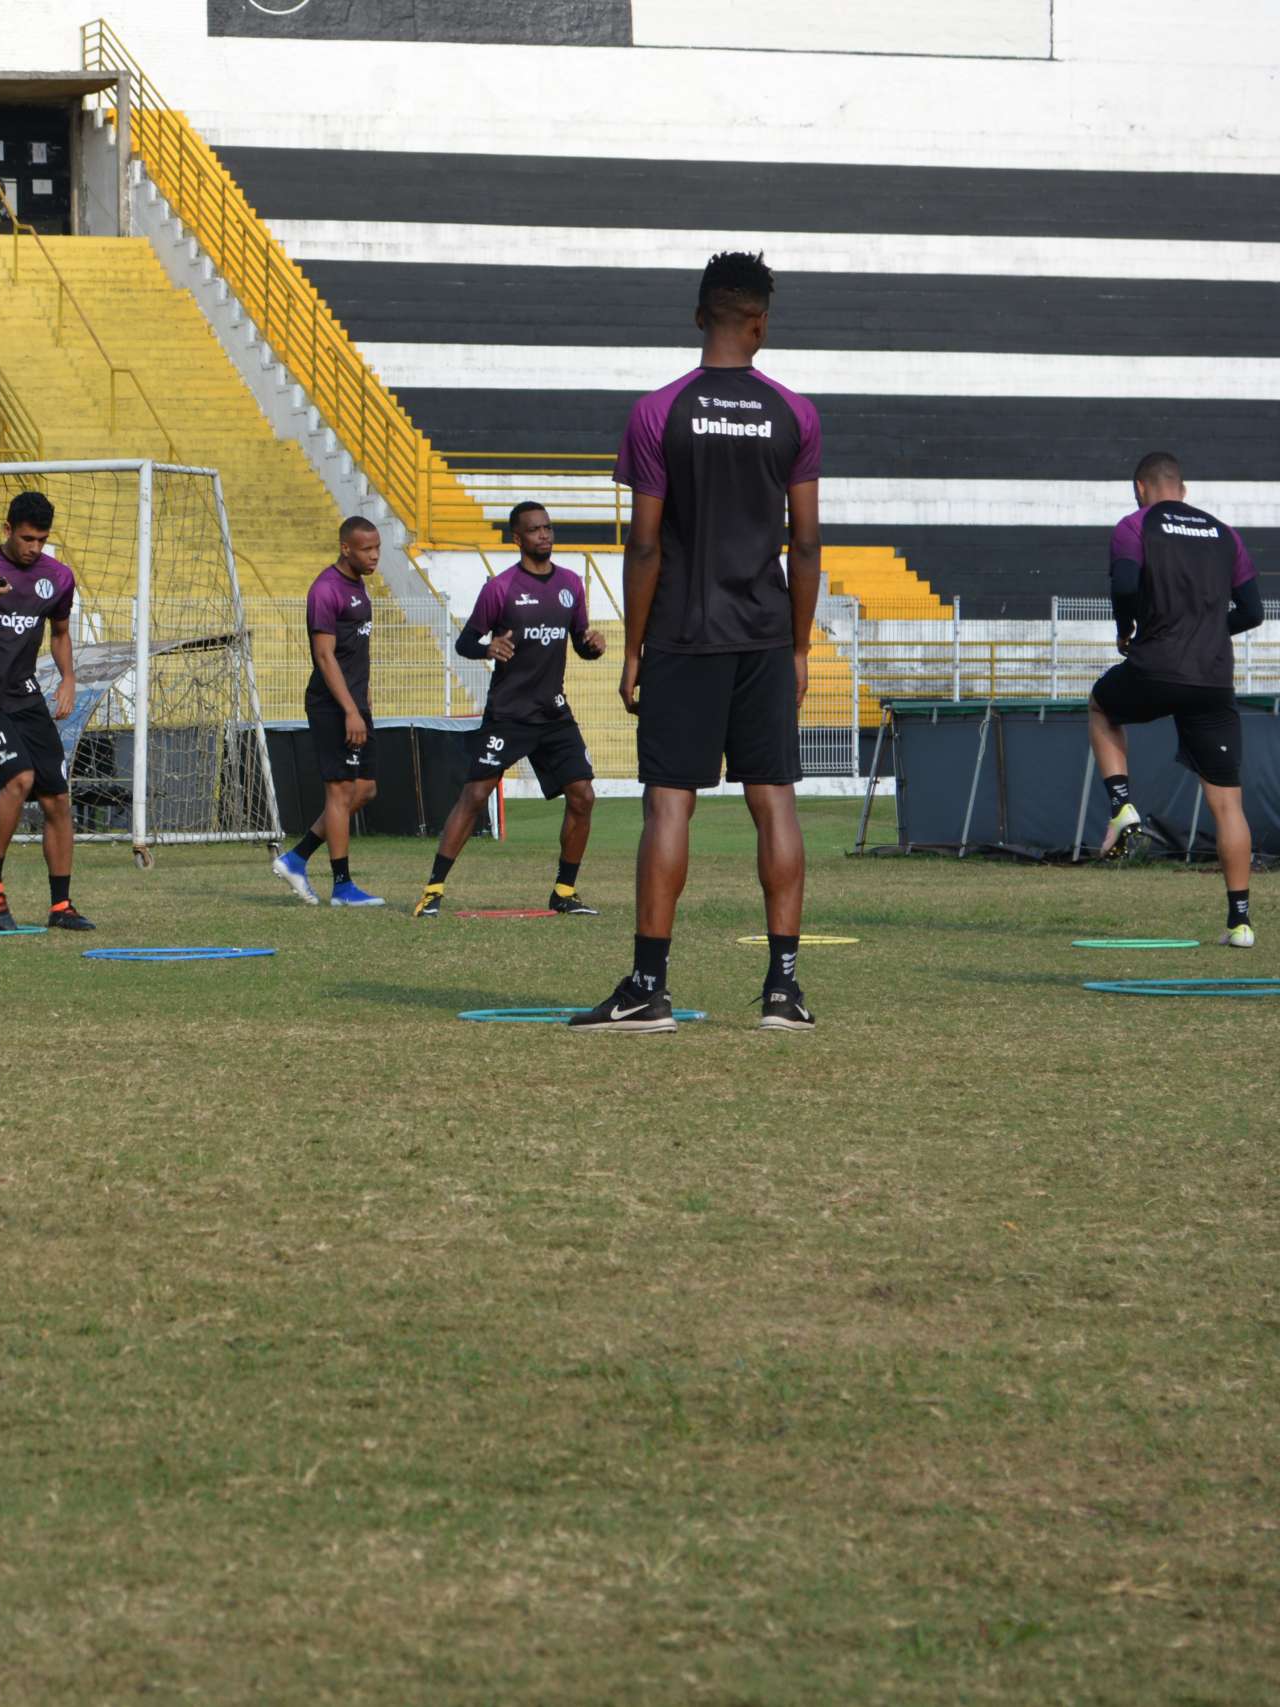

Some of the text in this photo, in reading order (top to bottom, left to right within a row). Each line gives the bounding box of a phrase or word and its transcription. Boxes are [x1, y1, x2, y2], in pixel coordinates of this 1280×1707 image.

[713, 398, 738, 408] Super
[692, 417, 772, 438] Unimed
[1161, 523, 1219, 538] Unimed
[486, 735, 504, 751] 30
